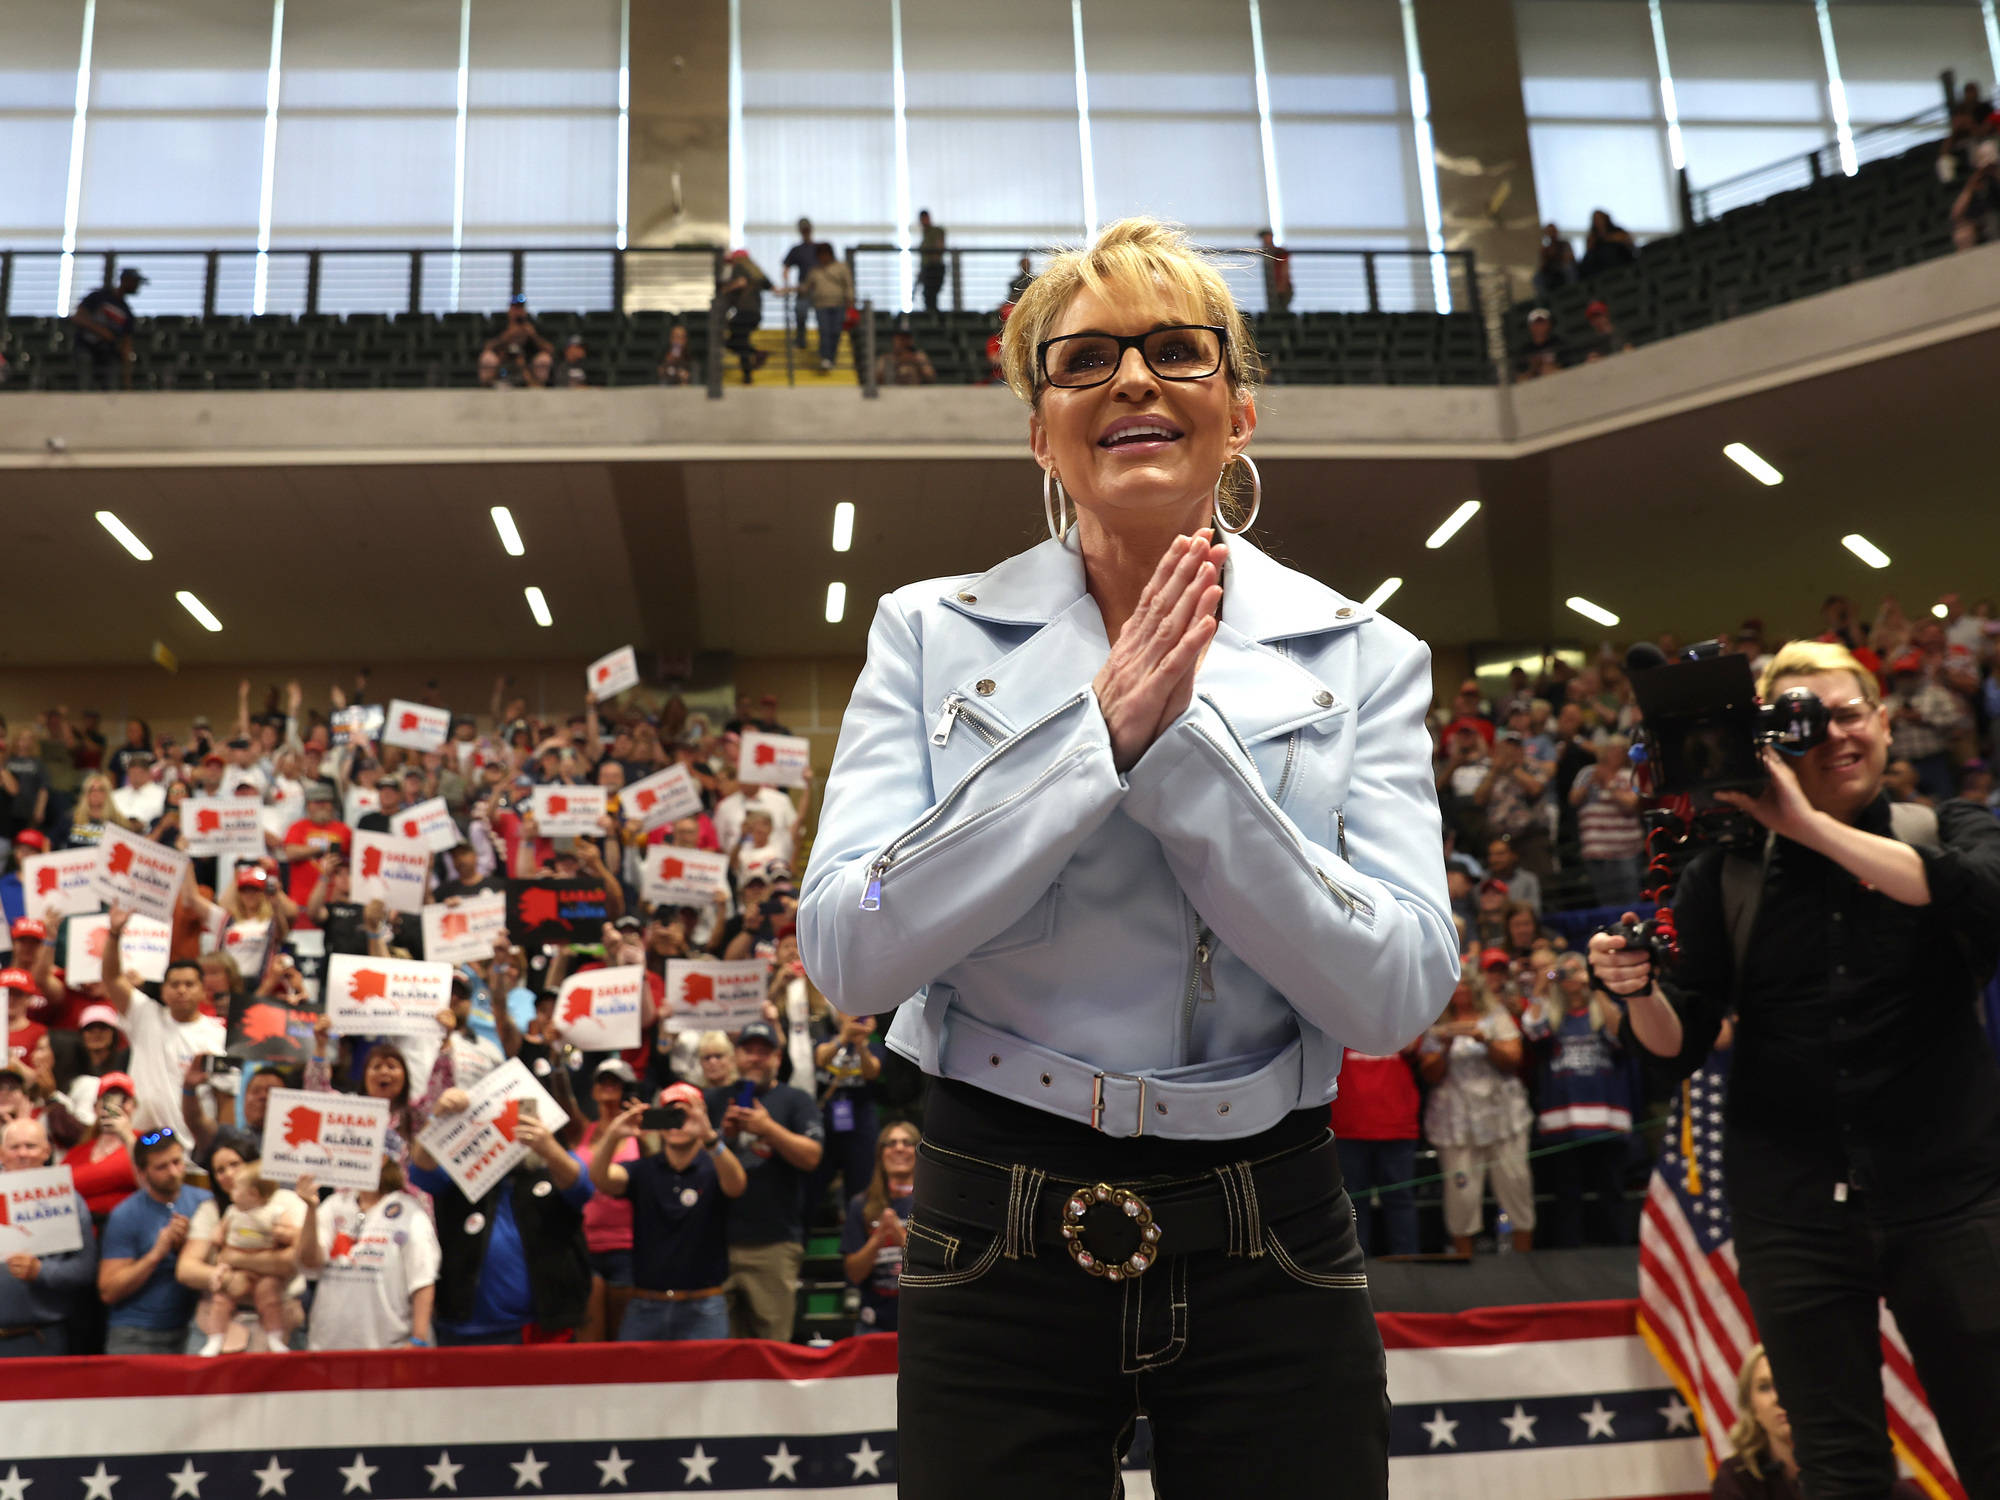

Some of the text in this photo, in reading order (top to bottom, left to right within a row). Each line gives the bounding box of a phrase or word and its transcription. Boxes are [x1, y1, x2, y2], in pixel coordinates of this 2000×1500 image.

[560, 889, 606, 903] SARAH
[560, 906, 606, 919] ALASKA
[391, 973, 441, 985] SARAH
[717, 973, 760, 985] SARAH
[596, 983, 638, 997] SARAH
[595, 1004, 637, 1016] ALASKA
[326, 1111, 378, 1128] SARAH
[323, 1132, 375, 1148] ALASKA
[464, 1140, 506, 1182] SARAH
[12, 1183, 71, 1204] SARAH
[15, 1203, 74, 1223] ALASKA
